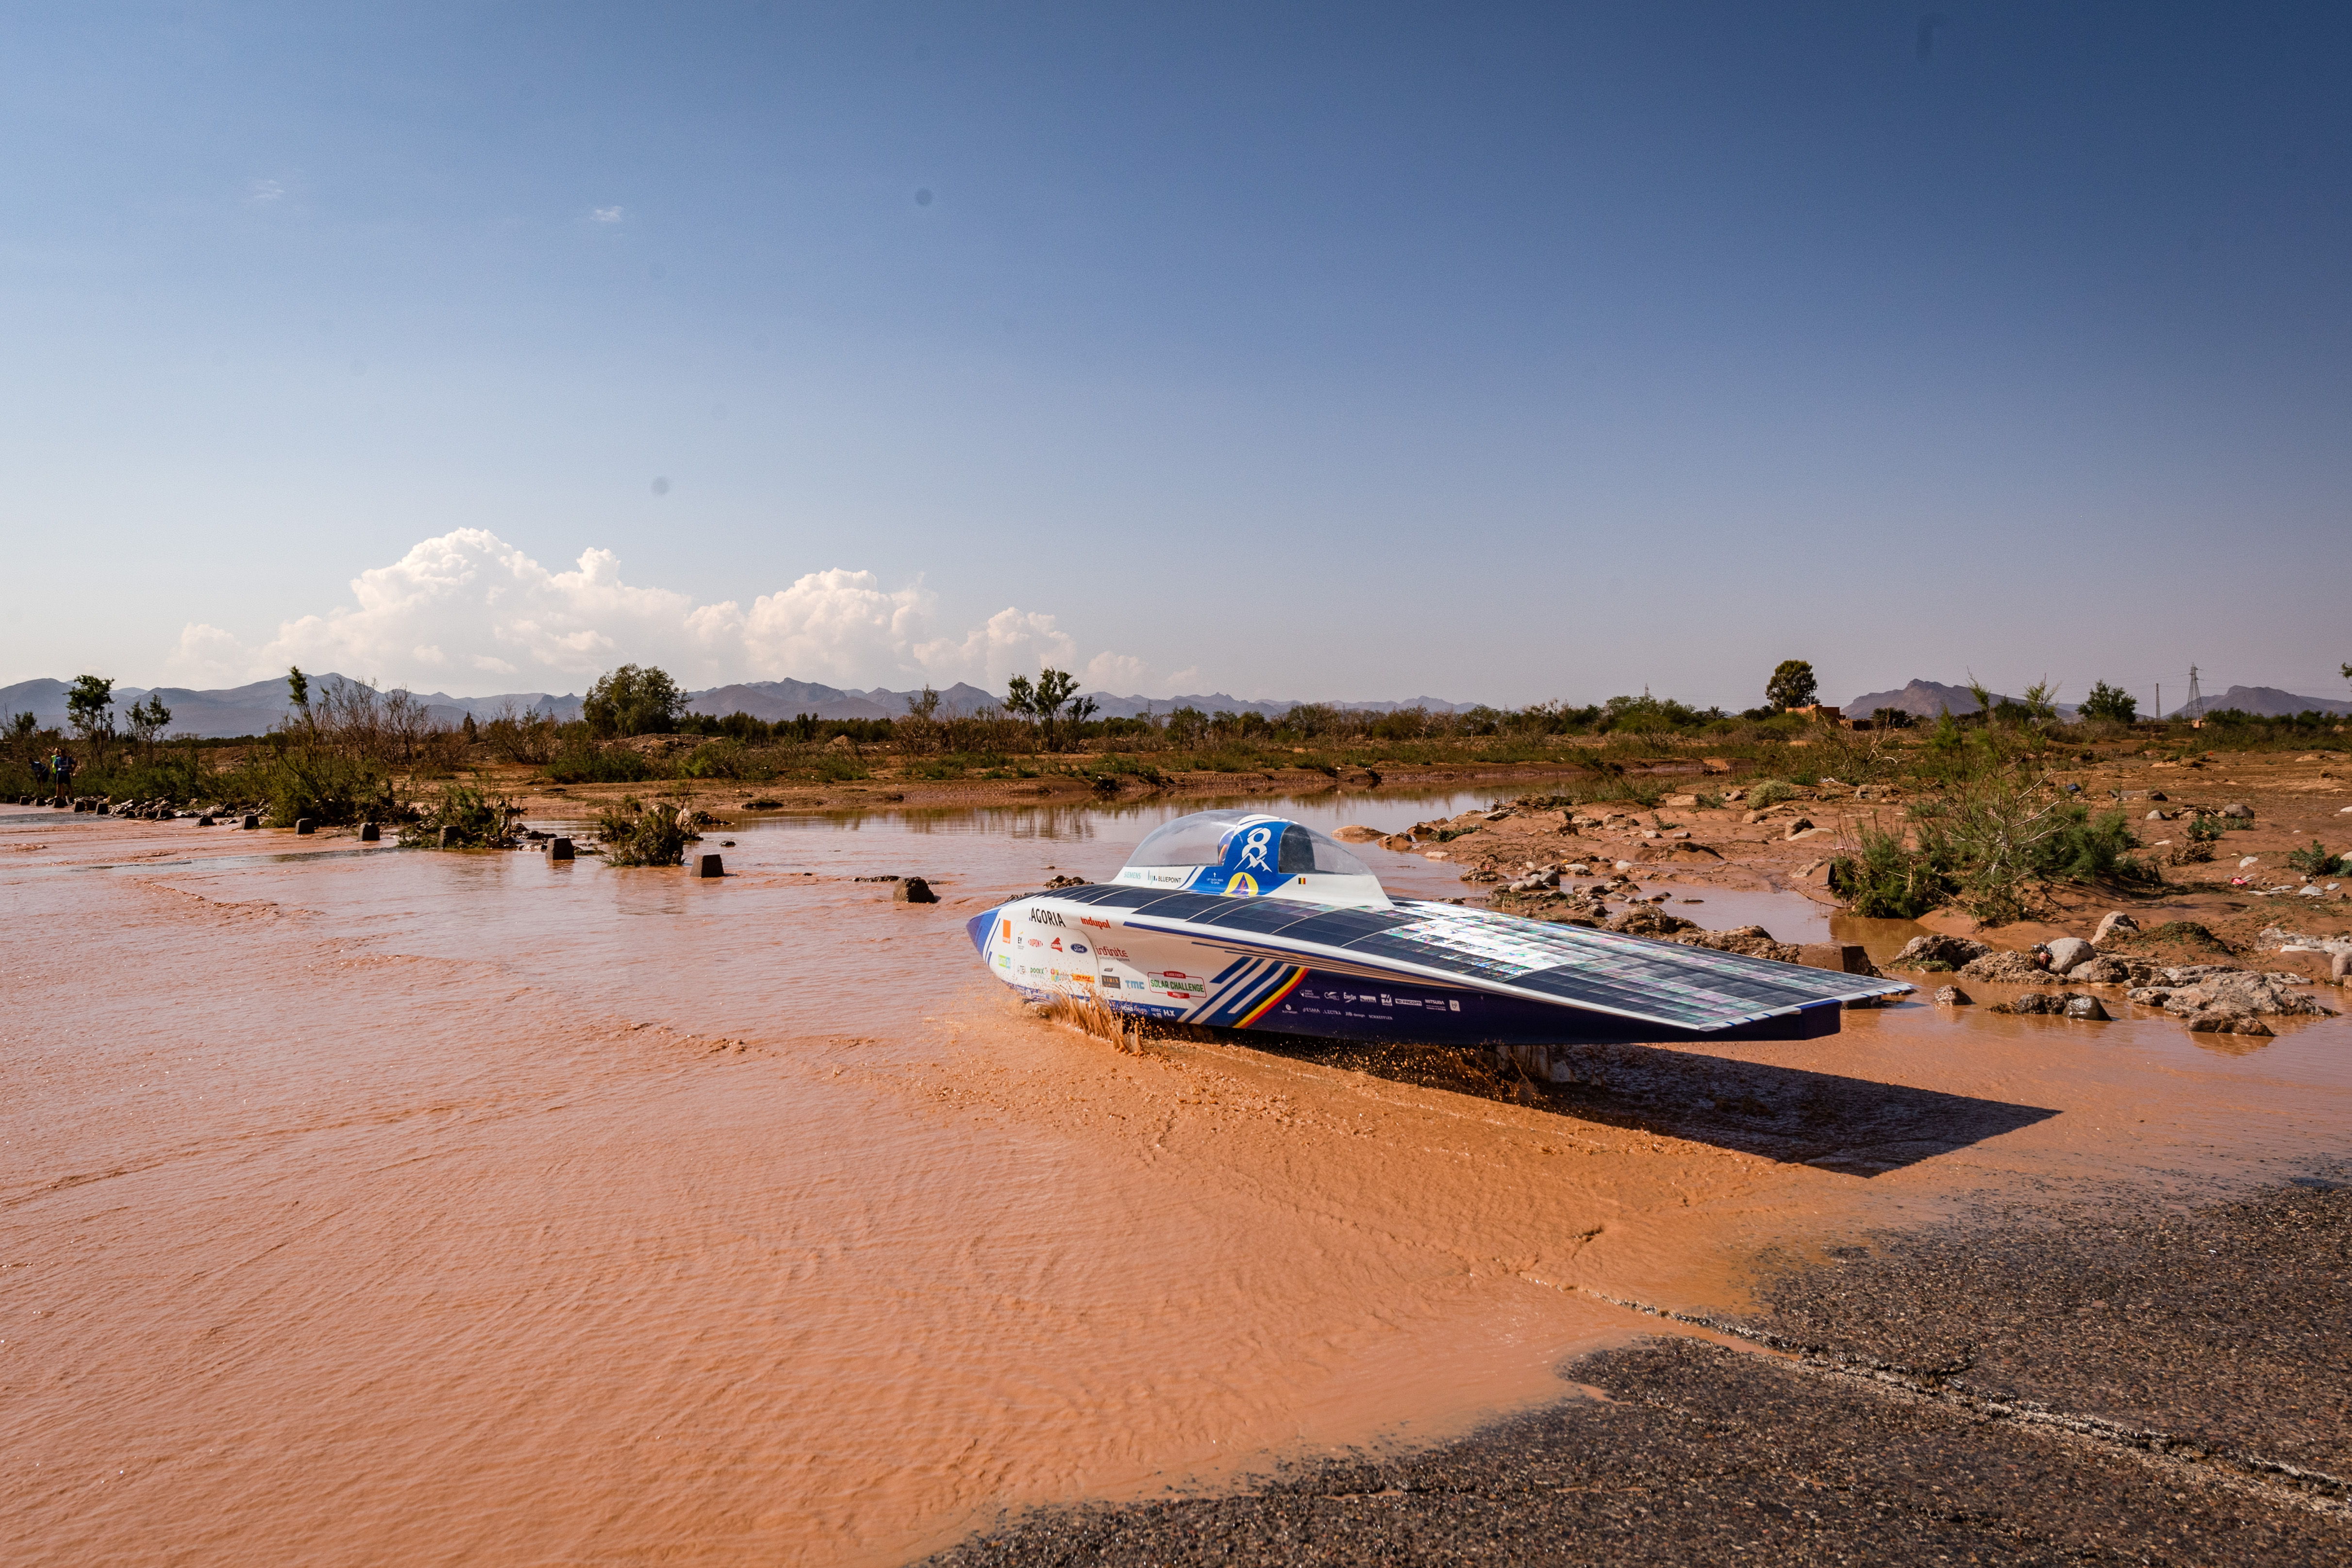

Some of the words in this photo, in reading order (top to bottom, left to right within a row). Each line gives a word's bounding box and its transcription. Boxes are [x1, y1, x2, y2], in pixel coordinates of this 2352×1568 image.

[1080, 917, 1111, 930] indupol
[1095, 945, 1129, 957] infinite
[1150, 979, 1169, 988] SOLAR
[1170, 981, 1204, 992] CHALLENGE
